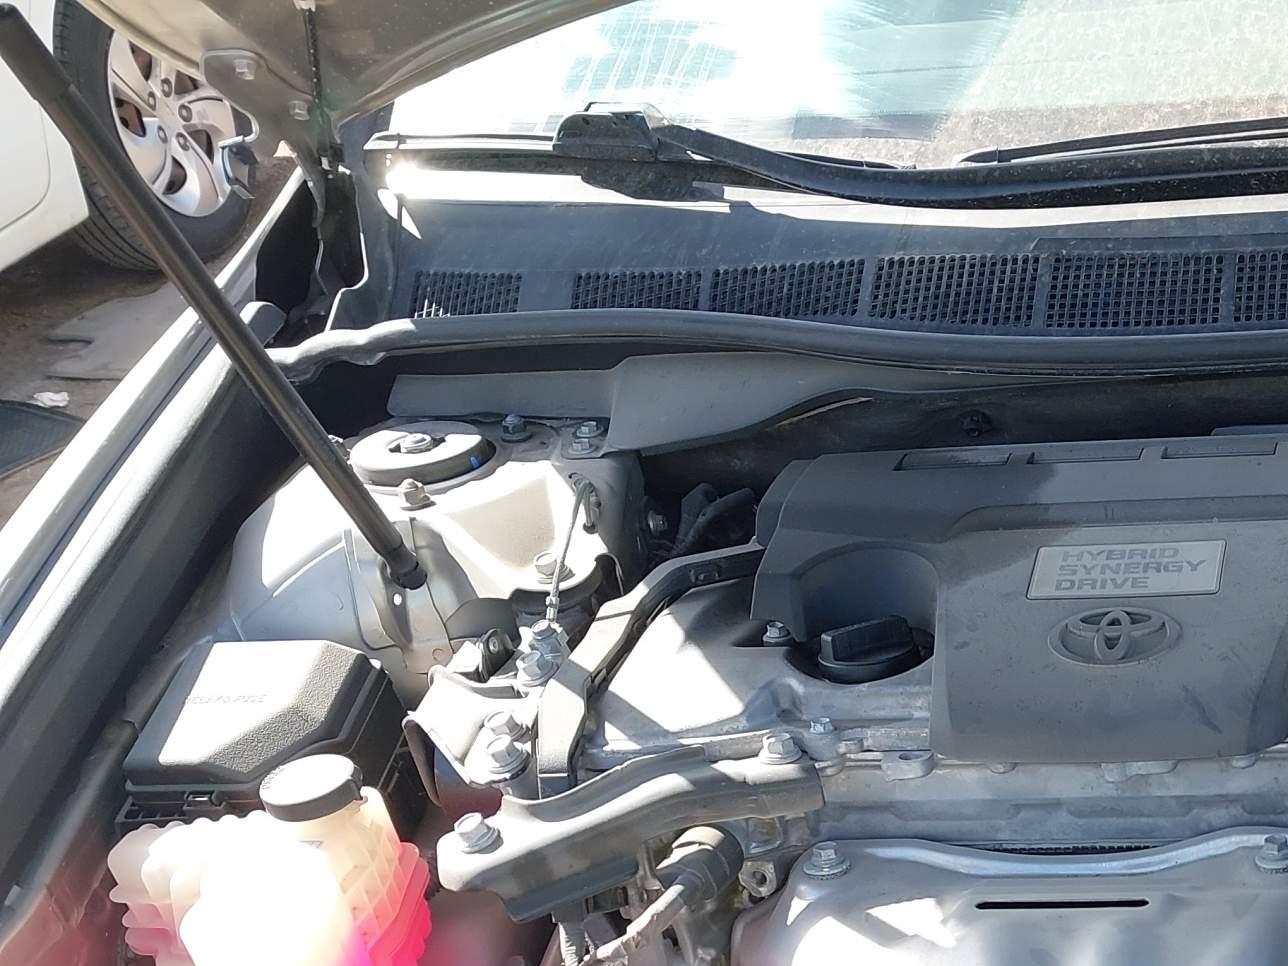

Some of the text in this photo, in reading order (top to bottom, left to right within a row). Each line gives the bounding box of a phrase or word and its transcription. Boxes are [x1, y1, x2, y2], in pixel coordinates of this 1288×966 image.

[1062, 547, 1179, 562] HYBRID
[1057, 560, 1206, 576] SYNERGY
[1055, 577, 1149, 591] DRIVE
